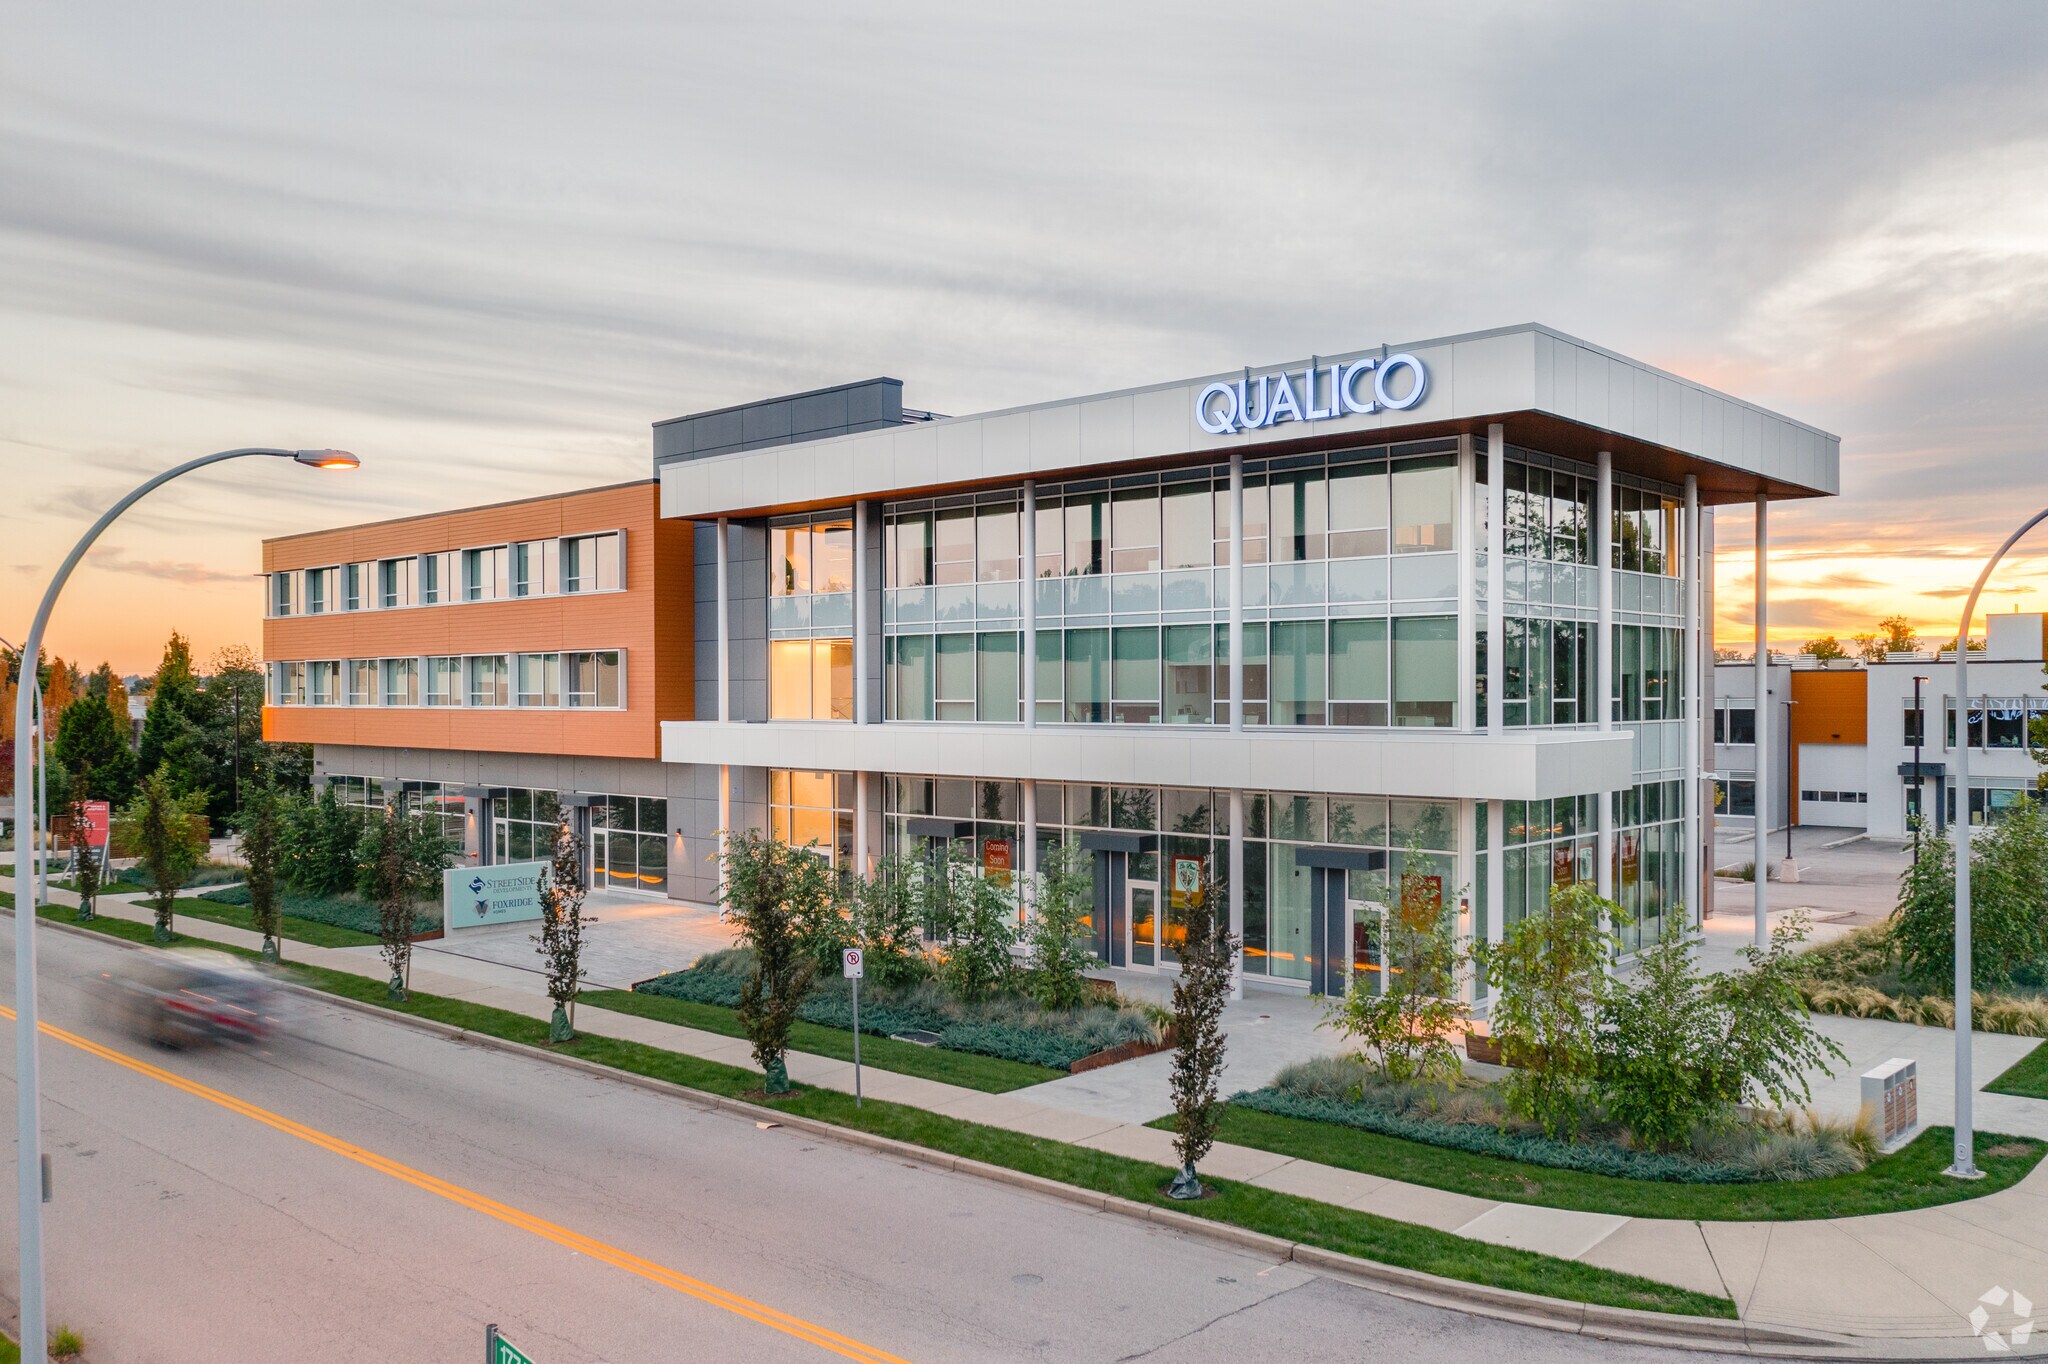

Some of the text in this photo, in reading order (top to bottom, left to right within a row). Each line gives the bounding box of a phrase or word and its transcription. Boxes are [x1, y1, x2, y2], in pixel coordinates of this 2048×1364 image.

[1195, 352, 1427, 435] QUALICO
[985, 840, 1009, 855] Coming
[989, 854, 1005, 865] Soon
[493, 886, 532, 894] DEVELOPMENTS
[492, 898, 533, 909] FOXRIDGE
